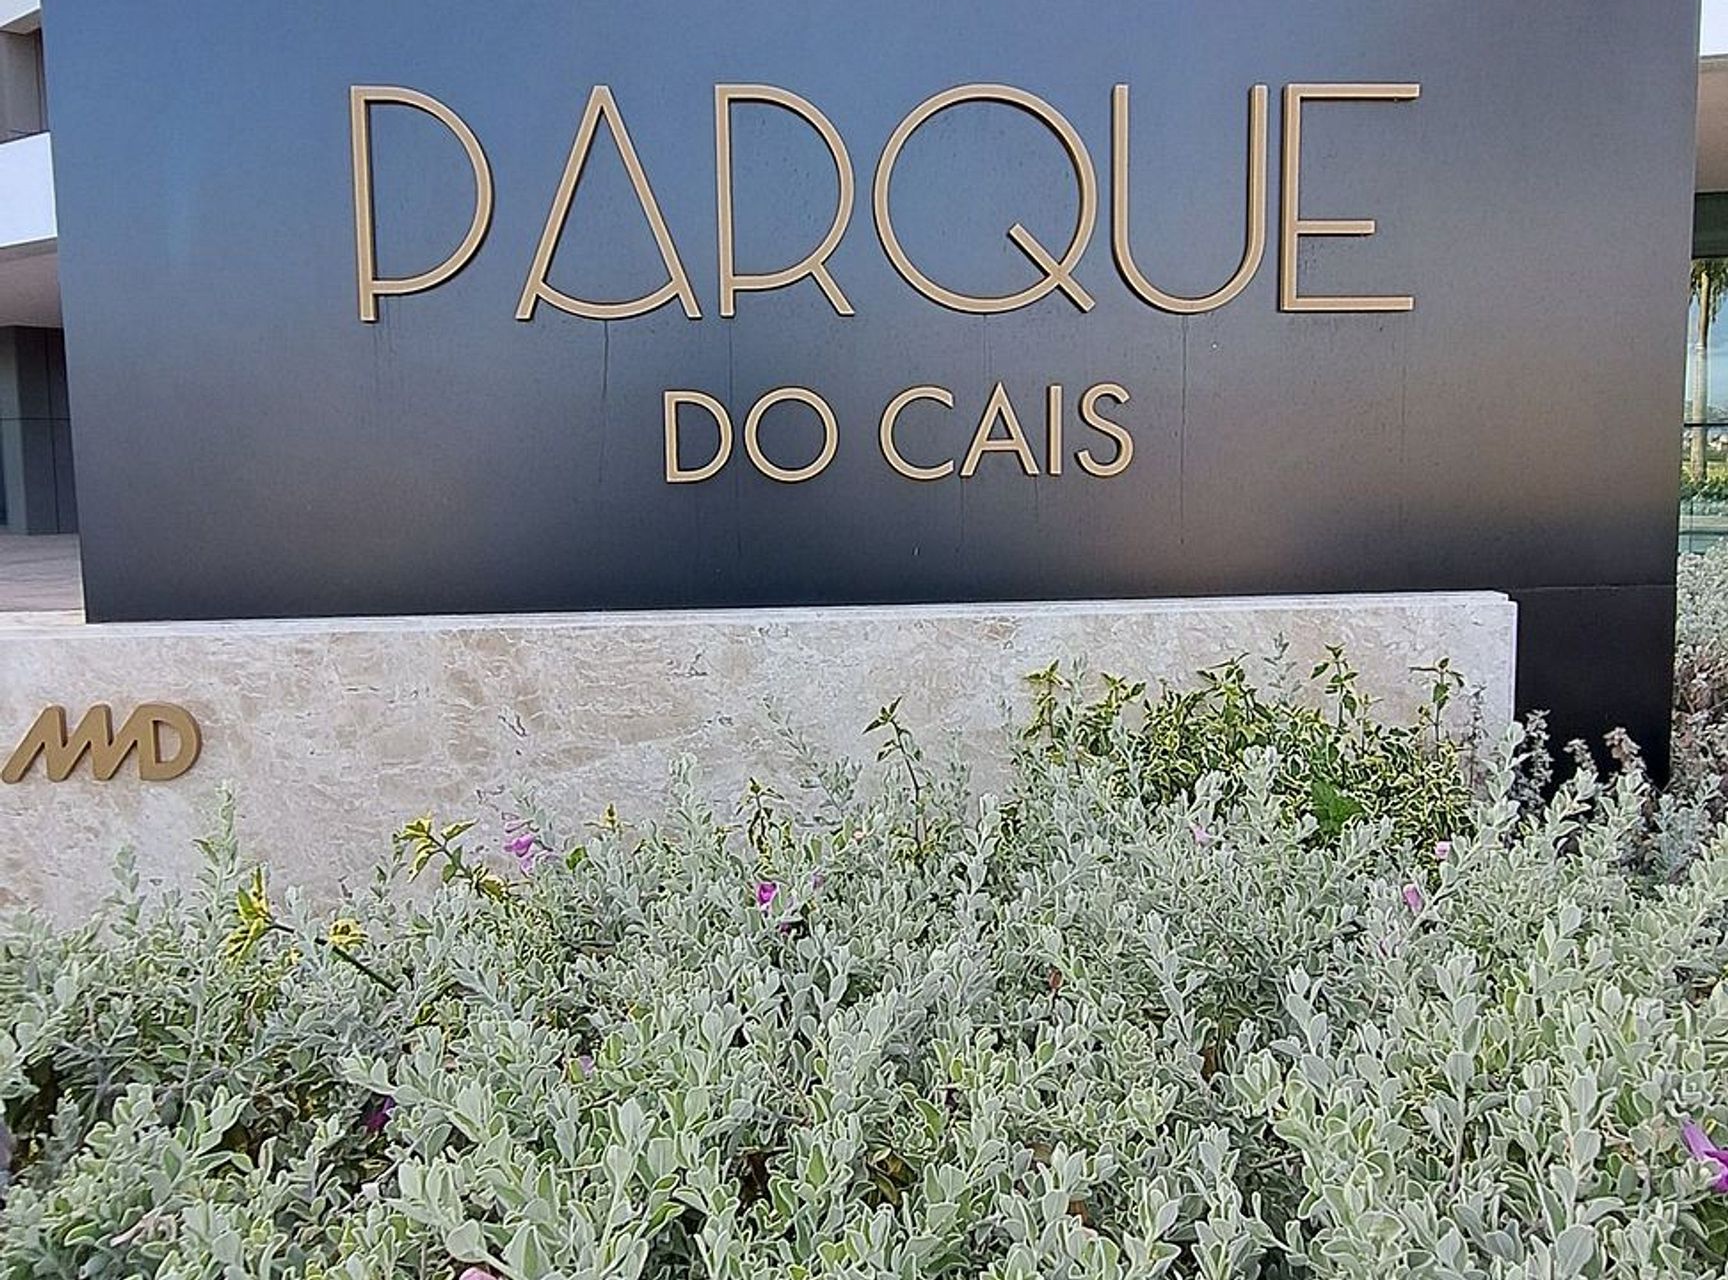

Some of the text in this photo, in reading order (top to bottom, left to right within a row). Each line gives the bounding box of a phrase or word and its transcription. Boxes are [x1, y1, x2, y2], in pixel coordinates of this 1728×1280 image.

[349, 82, 1421, 322] PARQUE
[663, 381, 1136, 484] DO CAIS
